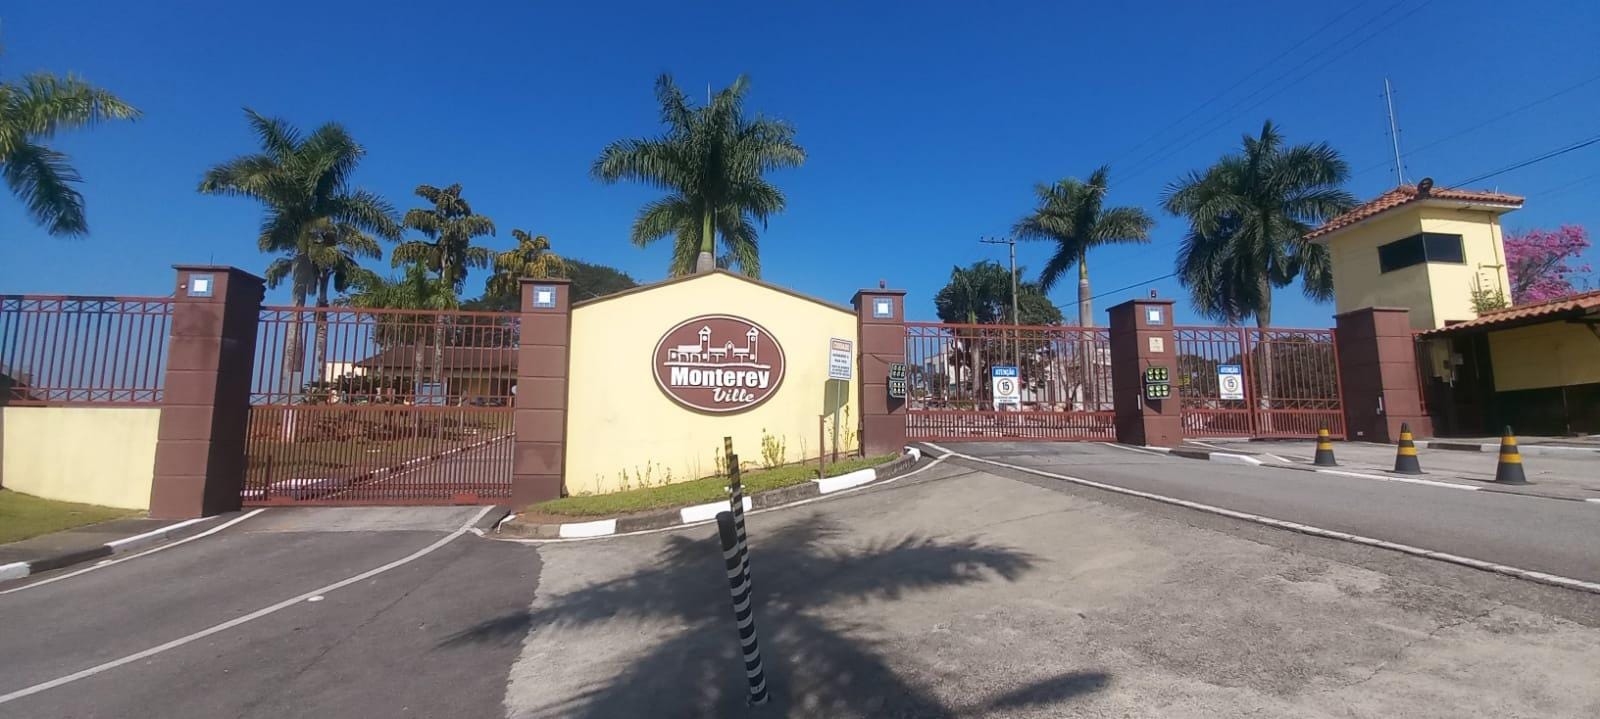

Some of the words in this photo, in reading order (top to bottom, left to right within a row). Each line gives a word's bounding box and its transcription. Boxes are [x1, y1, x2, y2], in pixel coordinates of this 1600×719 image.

[670, 366, 770, 389] Monterey
[1002, 381, 1010, 391] 15
[712, 387, 755, 402] Ville
